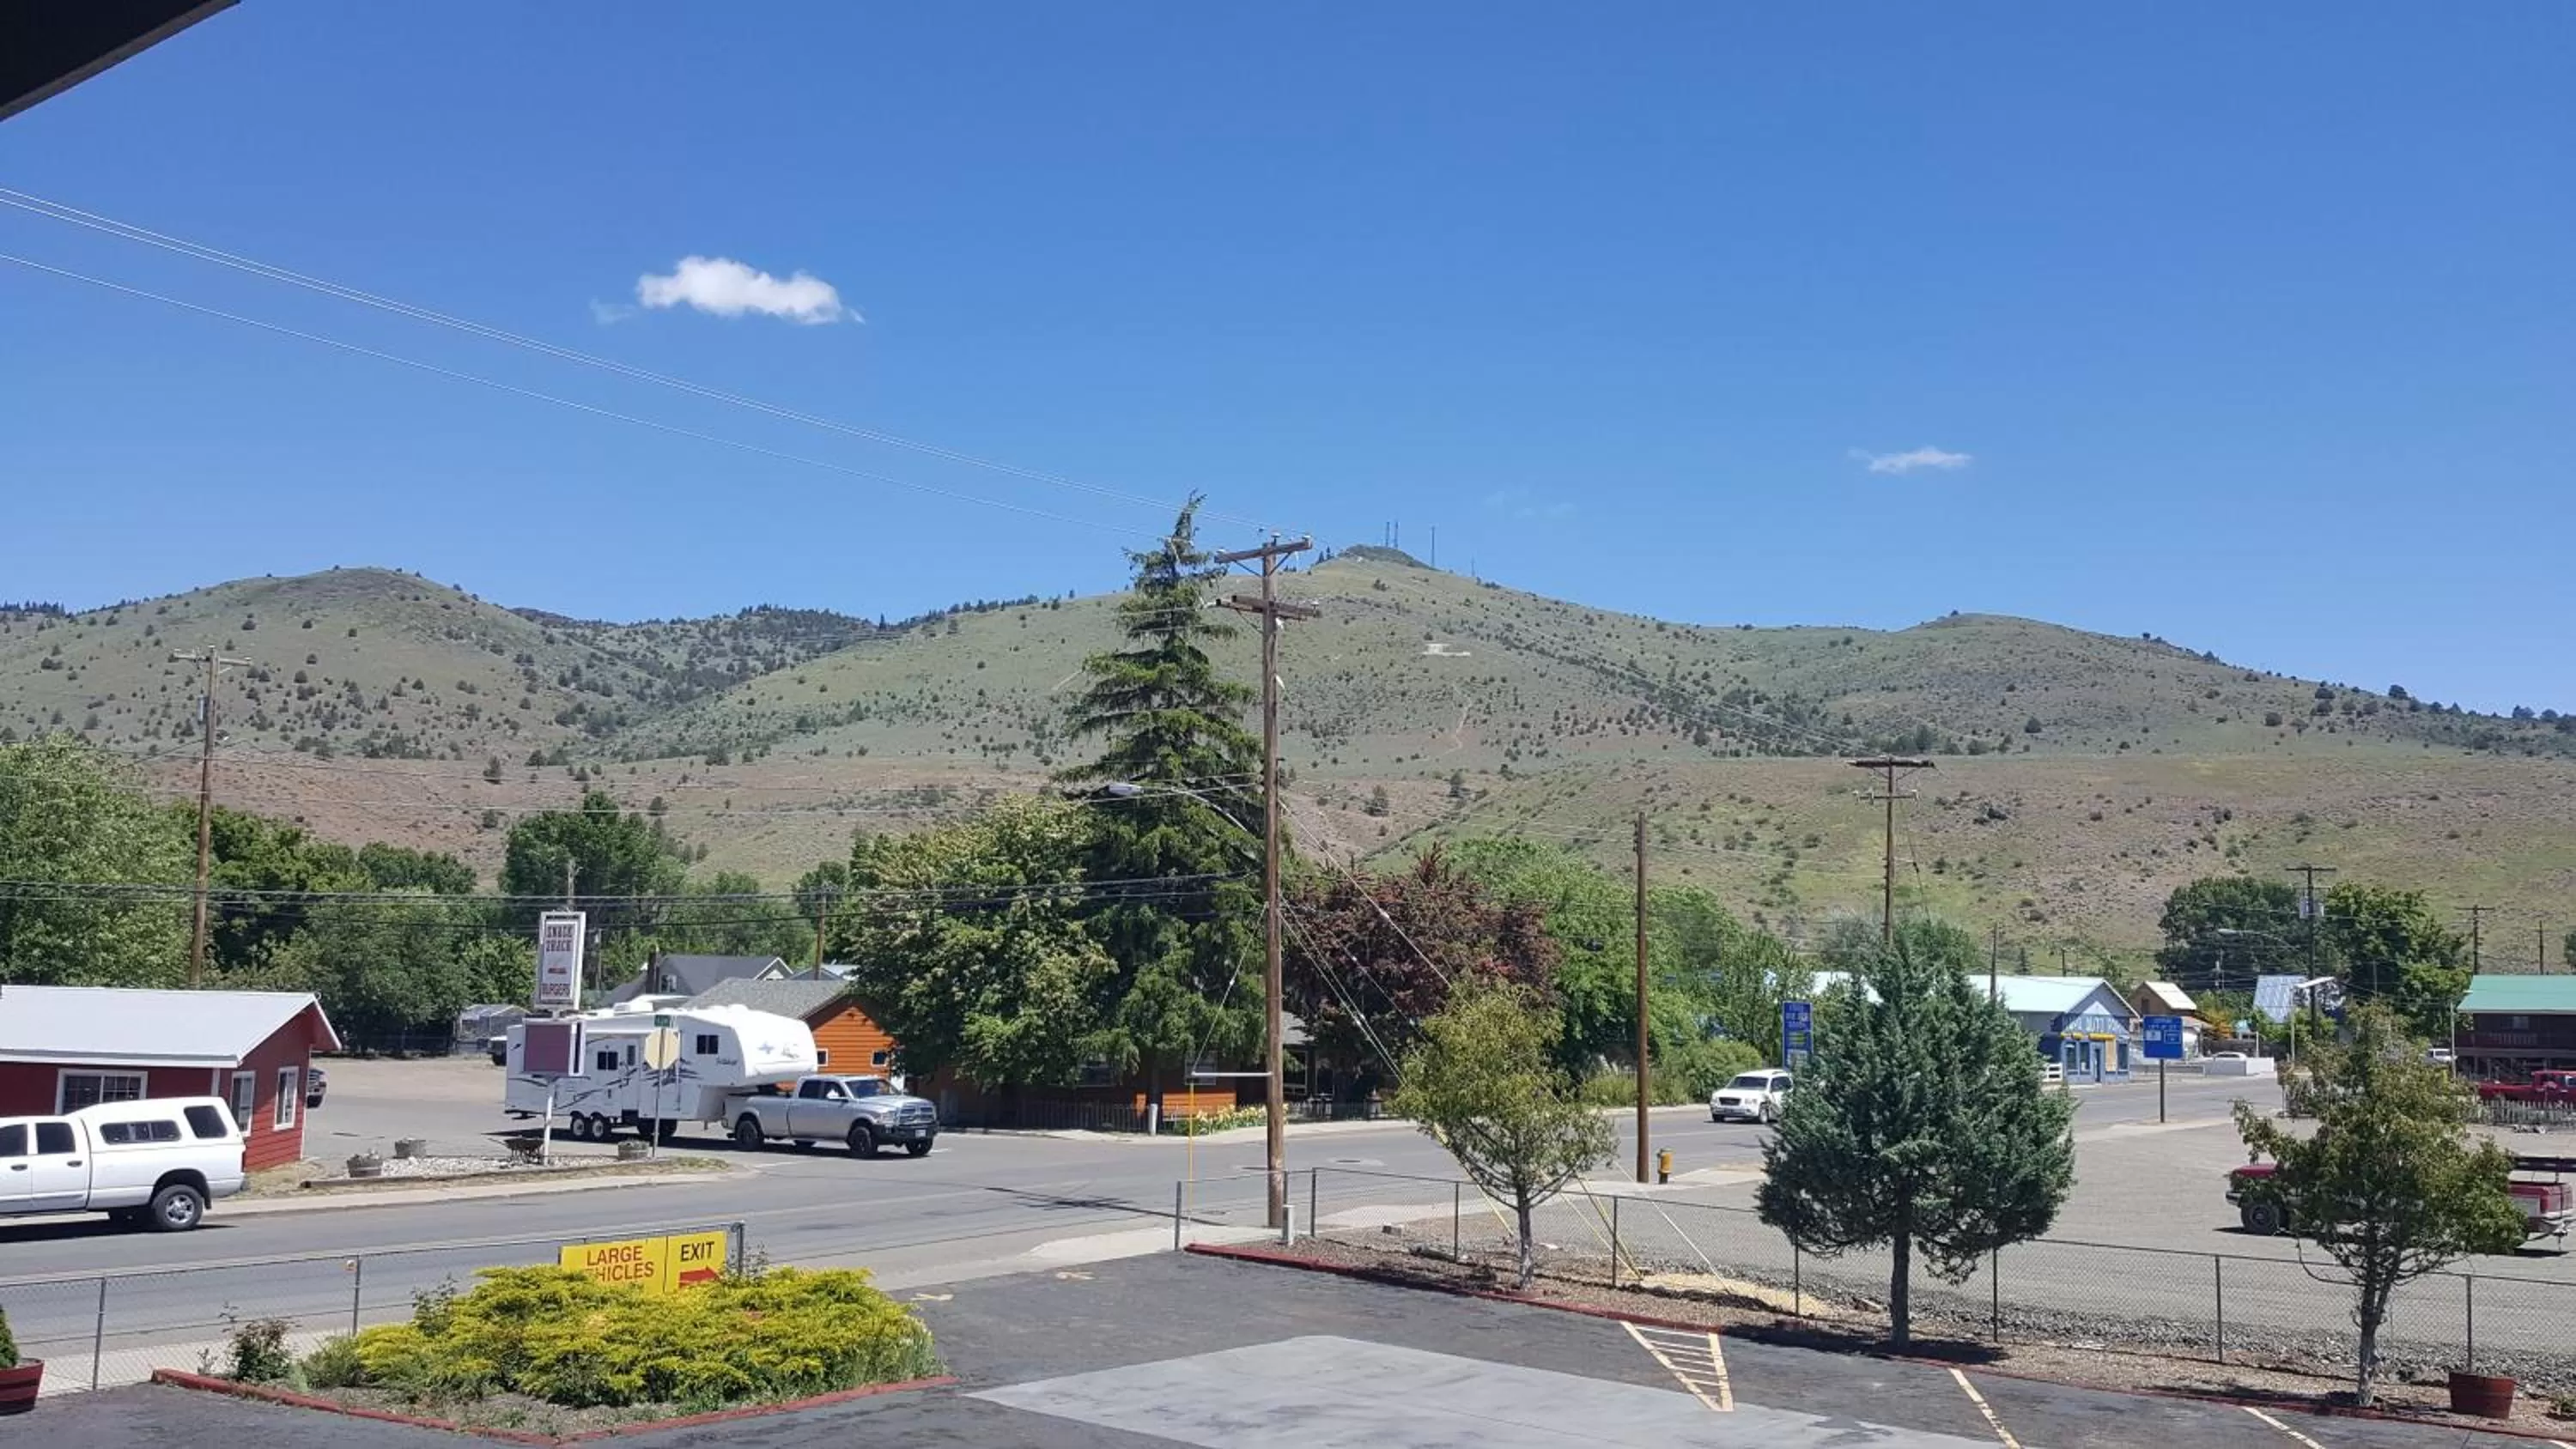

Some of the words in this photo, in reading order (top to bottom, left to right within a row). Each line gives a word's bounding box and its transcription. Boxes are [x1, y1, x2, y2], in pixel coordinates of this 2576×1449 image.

[545, 925, 573, 938] SNACK
[545, 939, 572, 952] SHACK
[586, 1245, 643, 1266] LARGE
[680, 1240, 715, 1262] EXIT
[585, 1261, 655, 1282] HICLES
